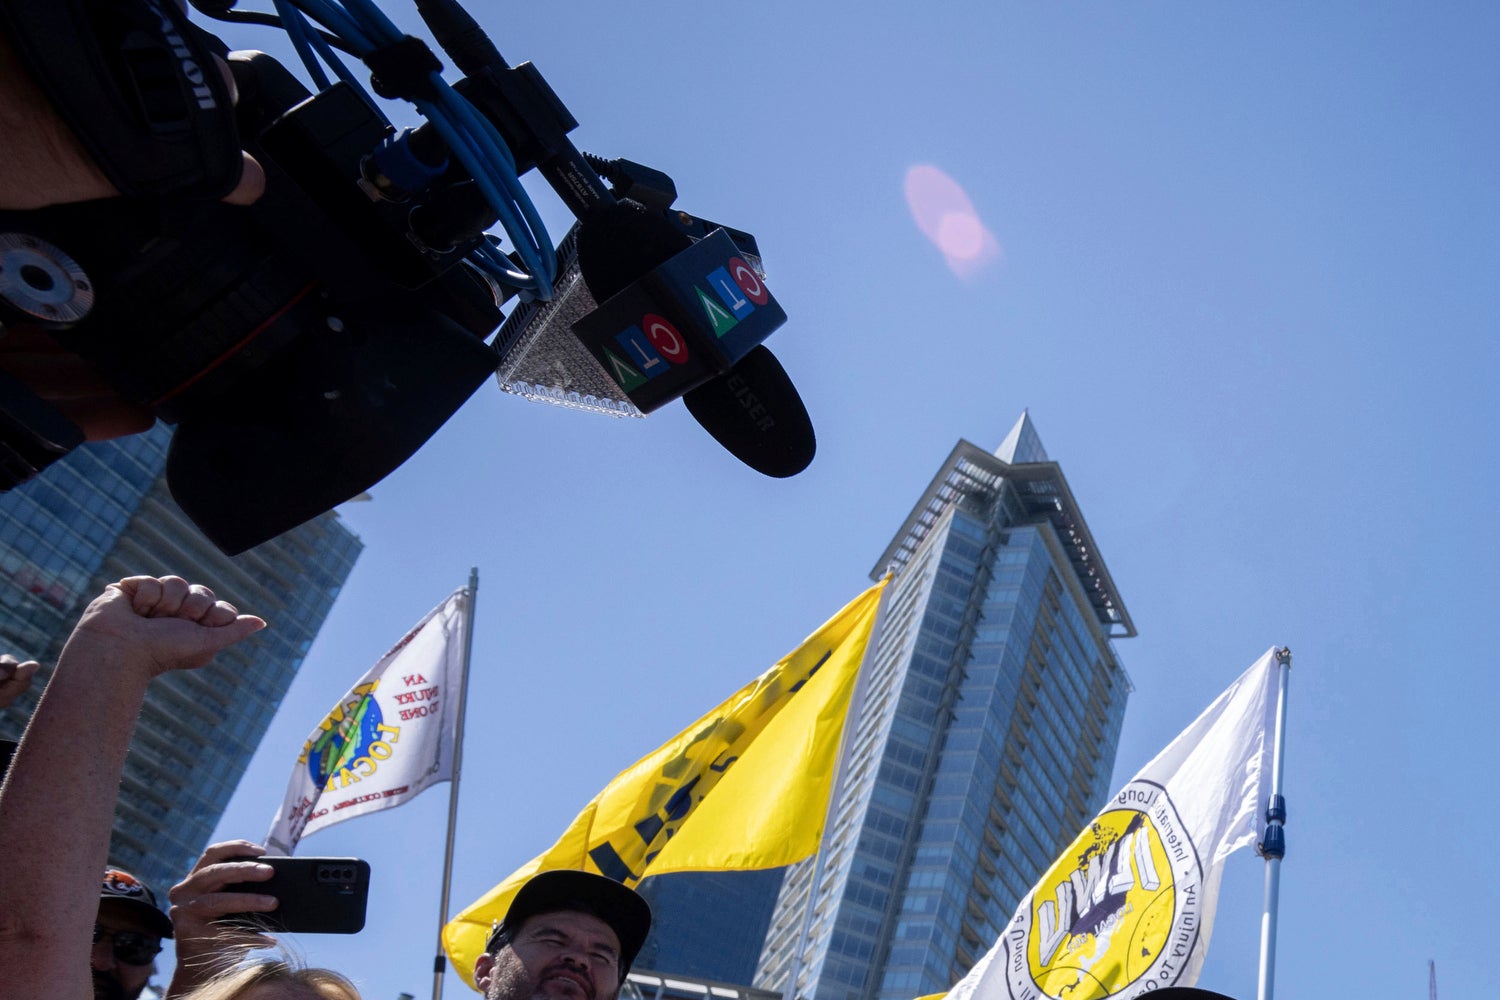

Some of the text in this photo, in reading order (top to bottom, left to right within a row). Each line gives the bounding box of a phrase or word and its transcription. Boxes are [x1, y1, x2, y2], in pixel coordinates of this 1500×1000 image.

[698, 262, 764, 332] CTV
[606, 318, 684, 389] CTV
[726, 376, 775, 432] EISER
